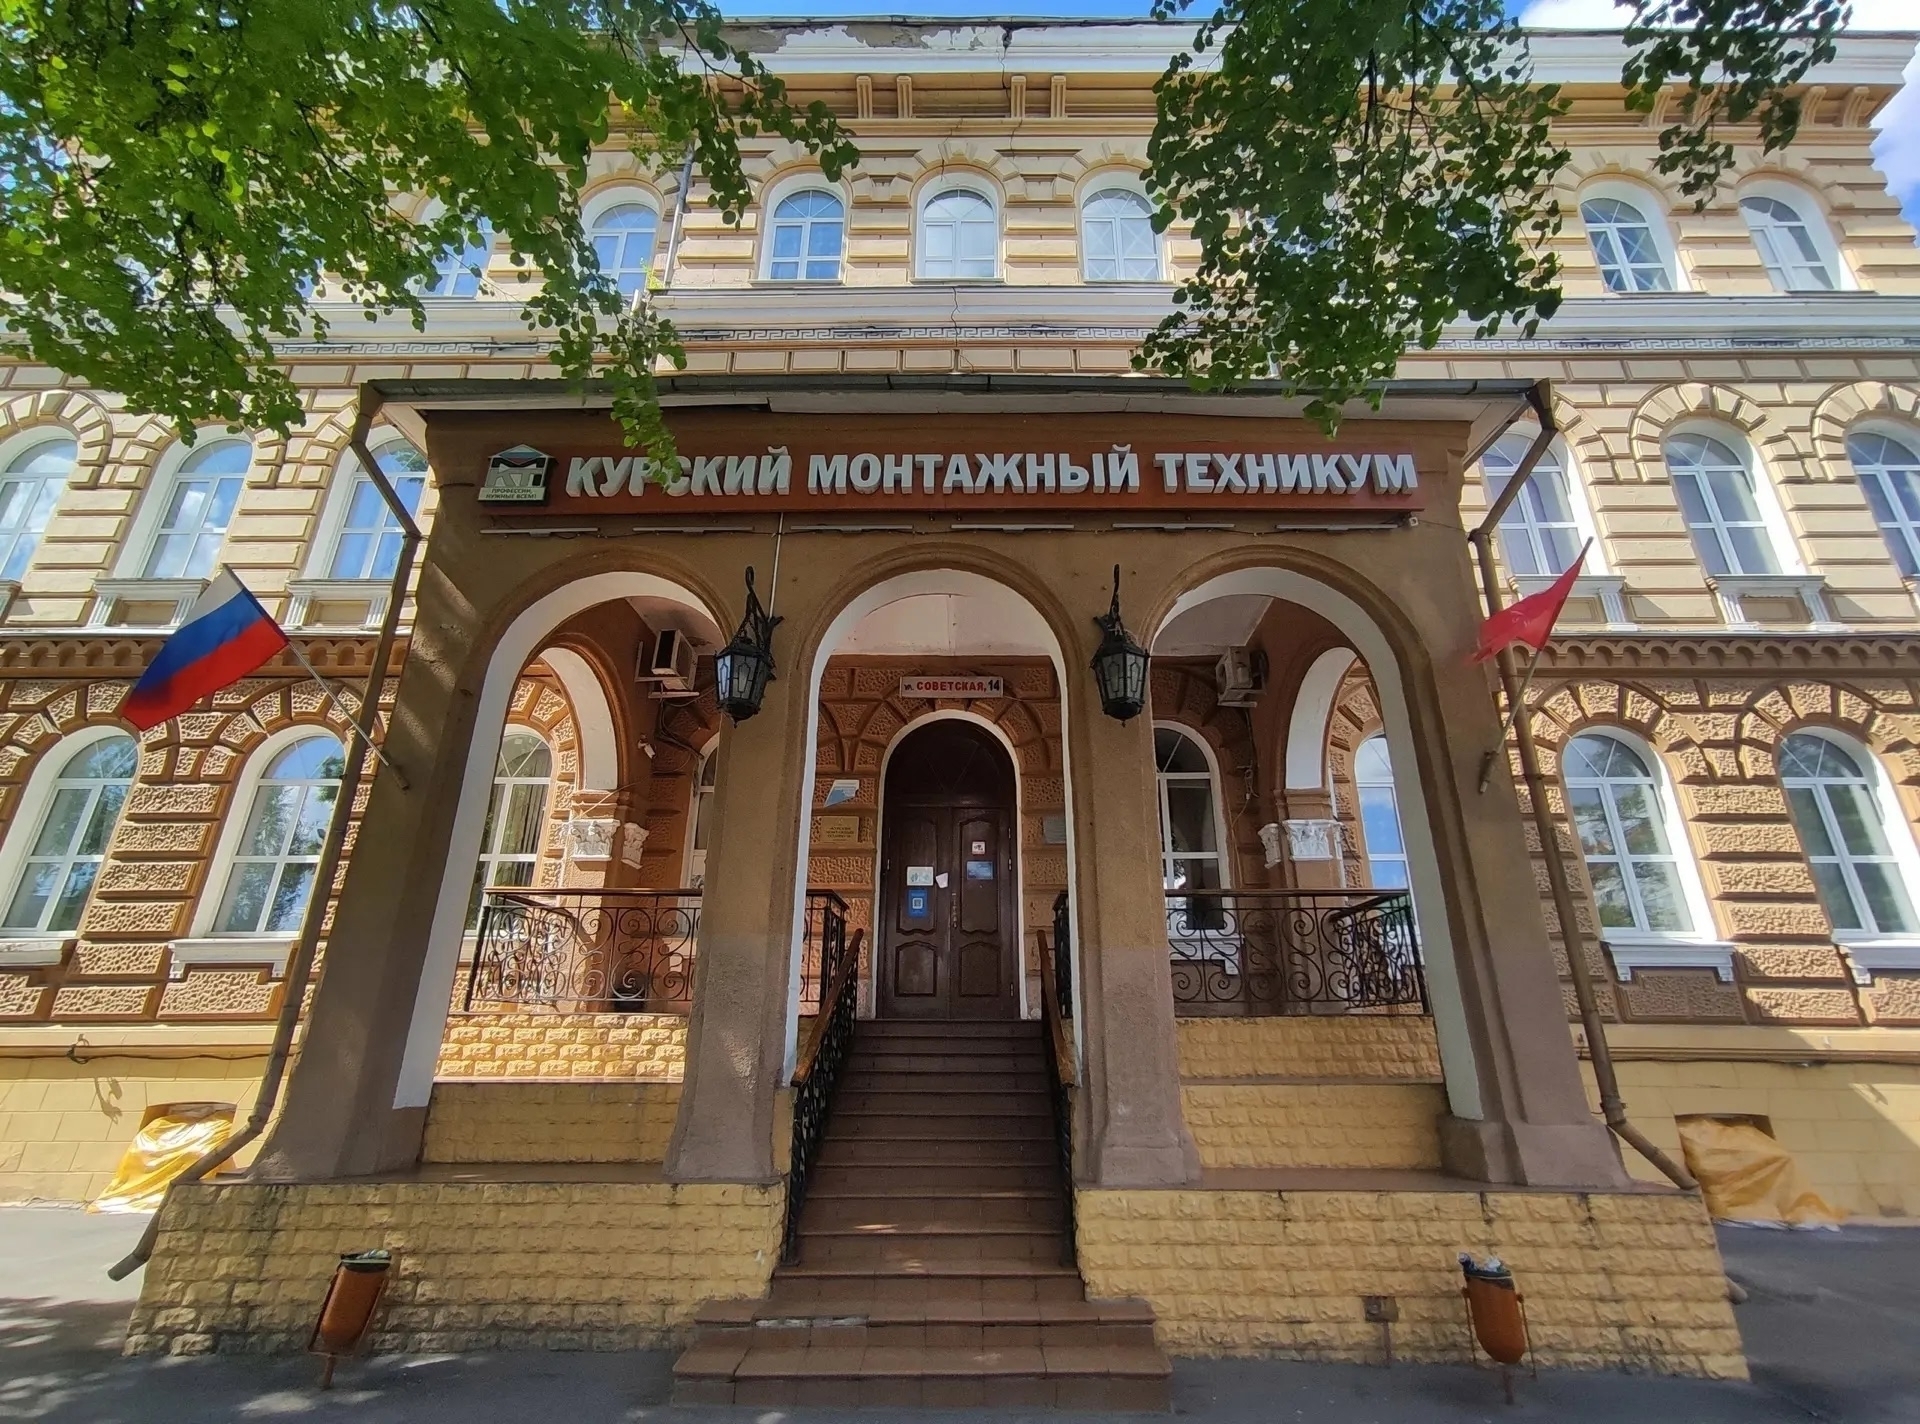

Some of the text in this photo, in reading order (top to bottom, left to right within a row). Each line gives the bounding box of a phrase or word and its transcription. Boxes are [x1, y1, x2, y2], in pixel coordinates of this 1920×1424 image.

[566, 444, 1419, 497] КУРСКИЙ МОНТАЖНЫЙ ТЕХНИКУМ
[904, 680, 1000, 692] ул. СОВЕТСКАЯ, 14
